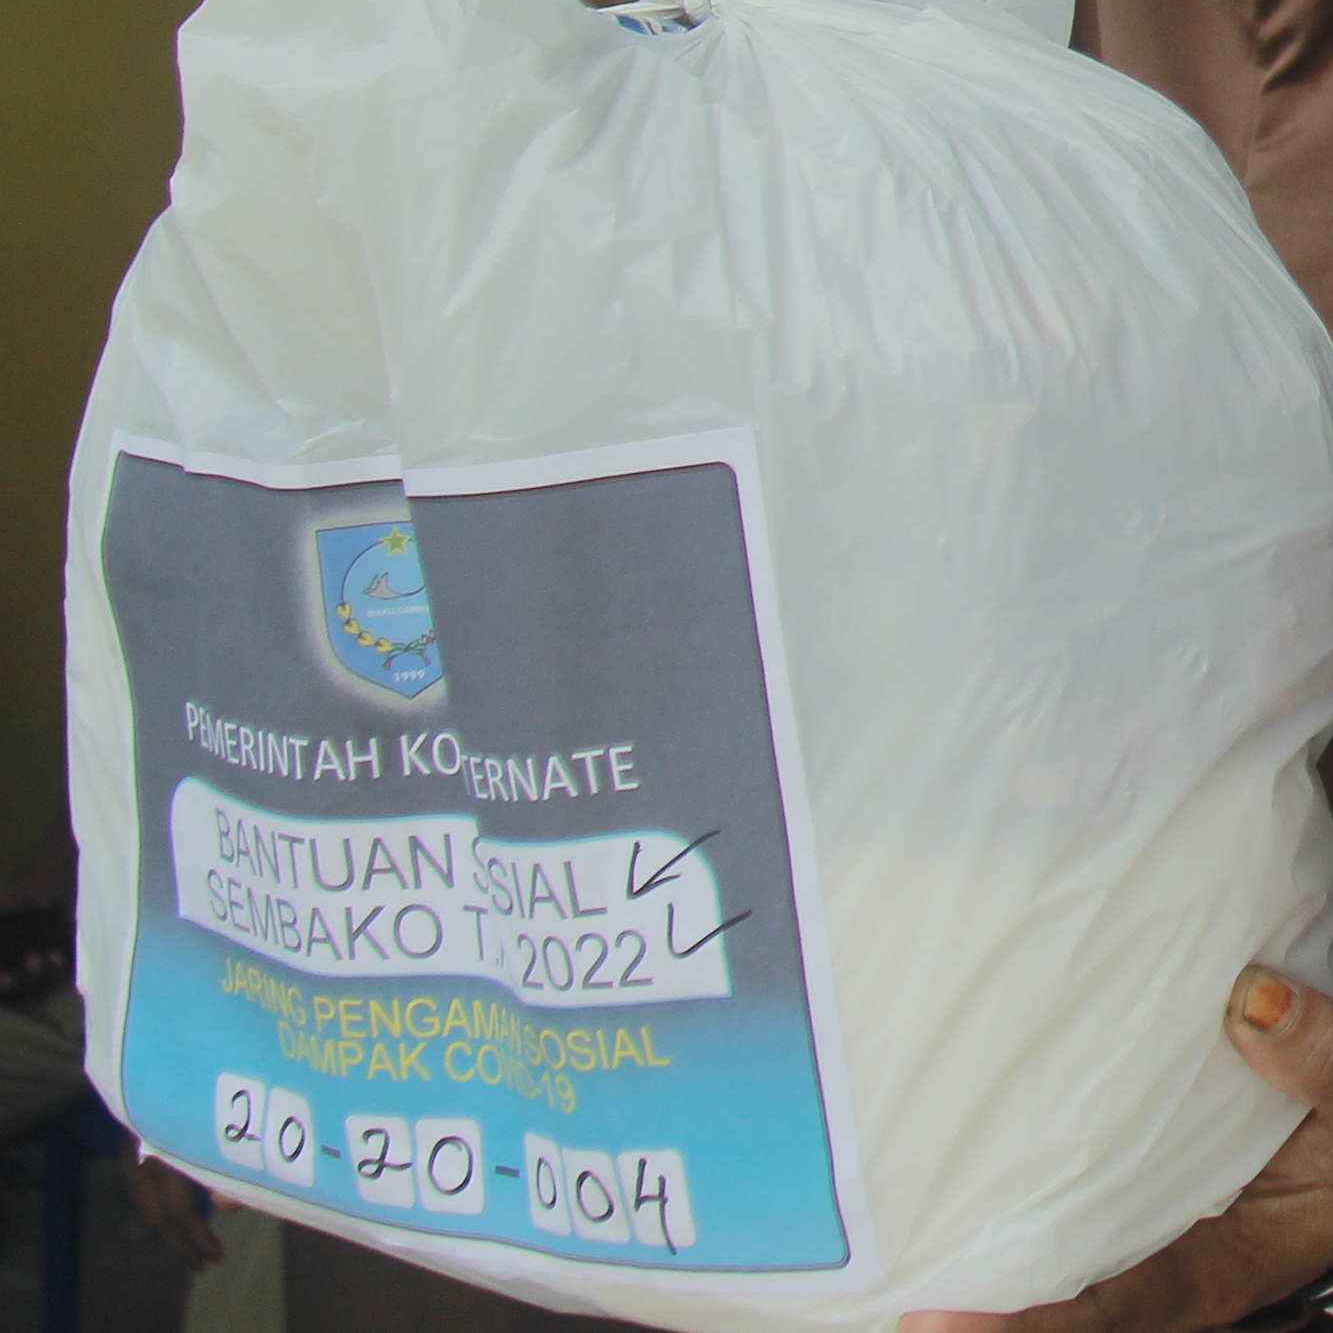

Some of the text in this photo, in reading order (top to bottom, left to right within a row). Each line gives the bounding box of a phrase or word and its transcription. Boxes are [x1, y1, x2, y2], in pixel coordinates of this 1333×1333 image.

[393, 669, 426, 684] 1999
[185, 701, 380, 781] PEMERINTAH
[400, 732, 461, 776] KO
[216, 808, 607, 919] BANTUAN SSIAL
[206, 868, 442, 961] SEMBAKO
[517, 930, 652, 991] 2022
[222, 958, 307, 1026] JARING
[524, 1026, 671, 1071] SOSIAL
[277, 1020, 576, 1114] DAMPAK COD-19
